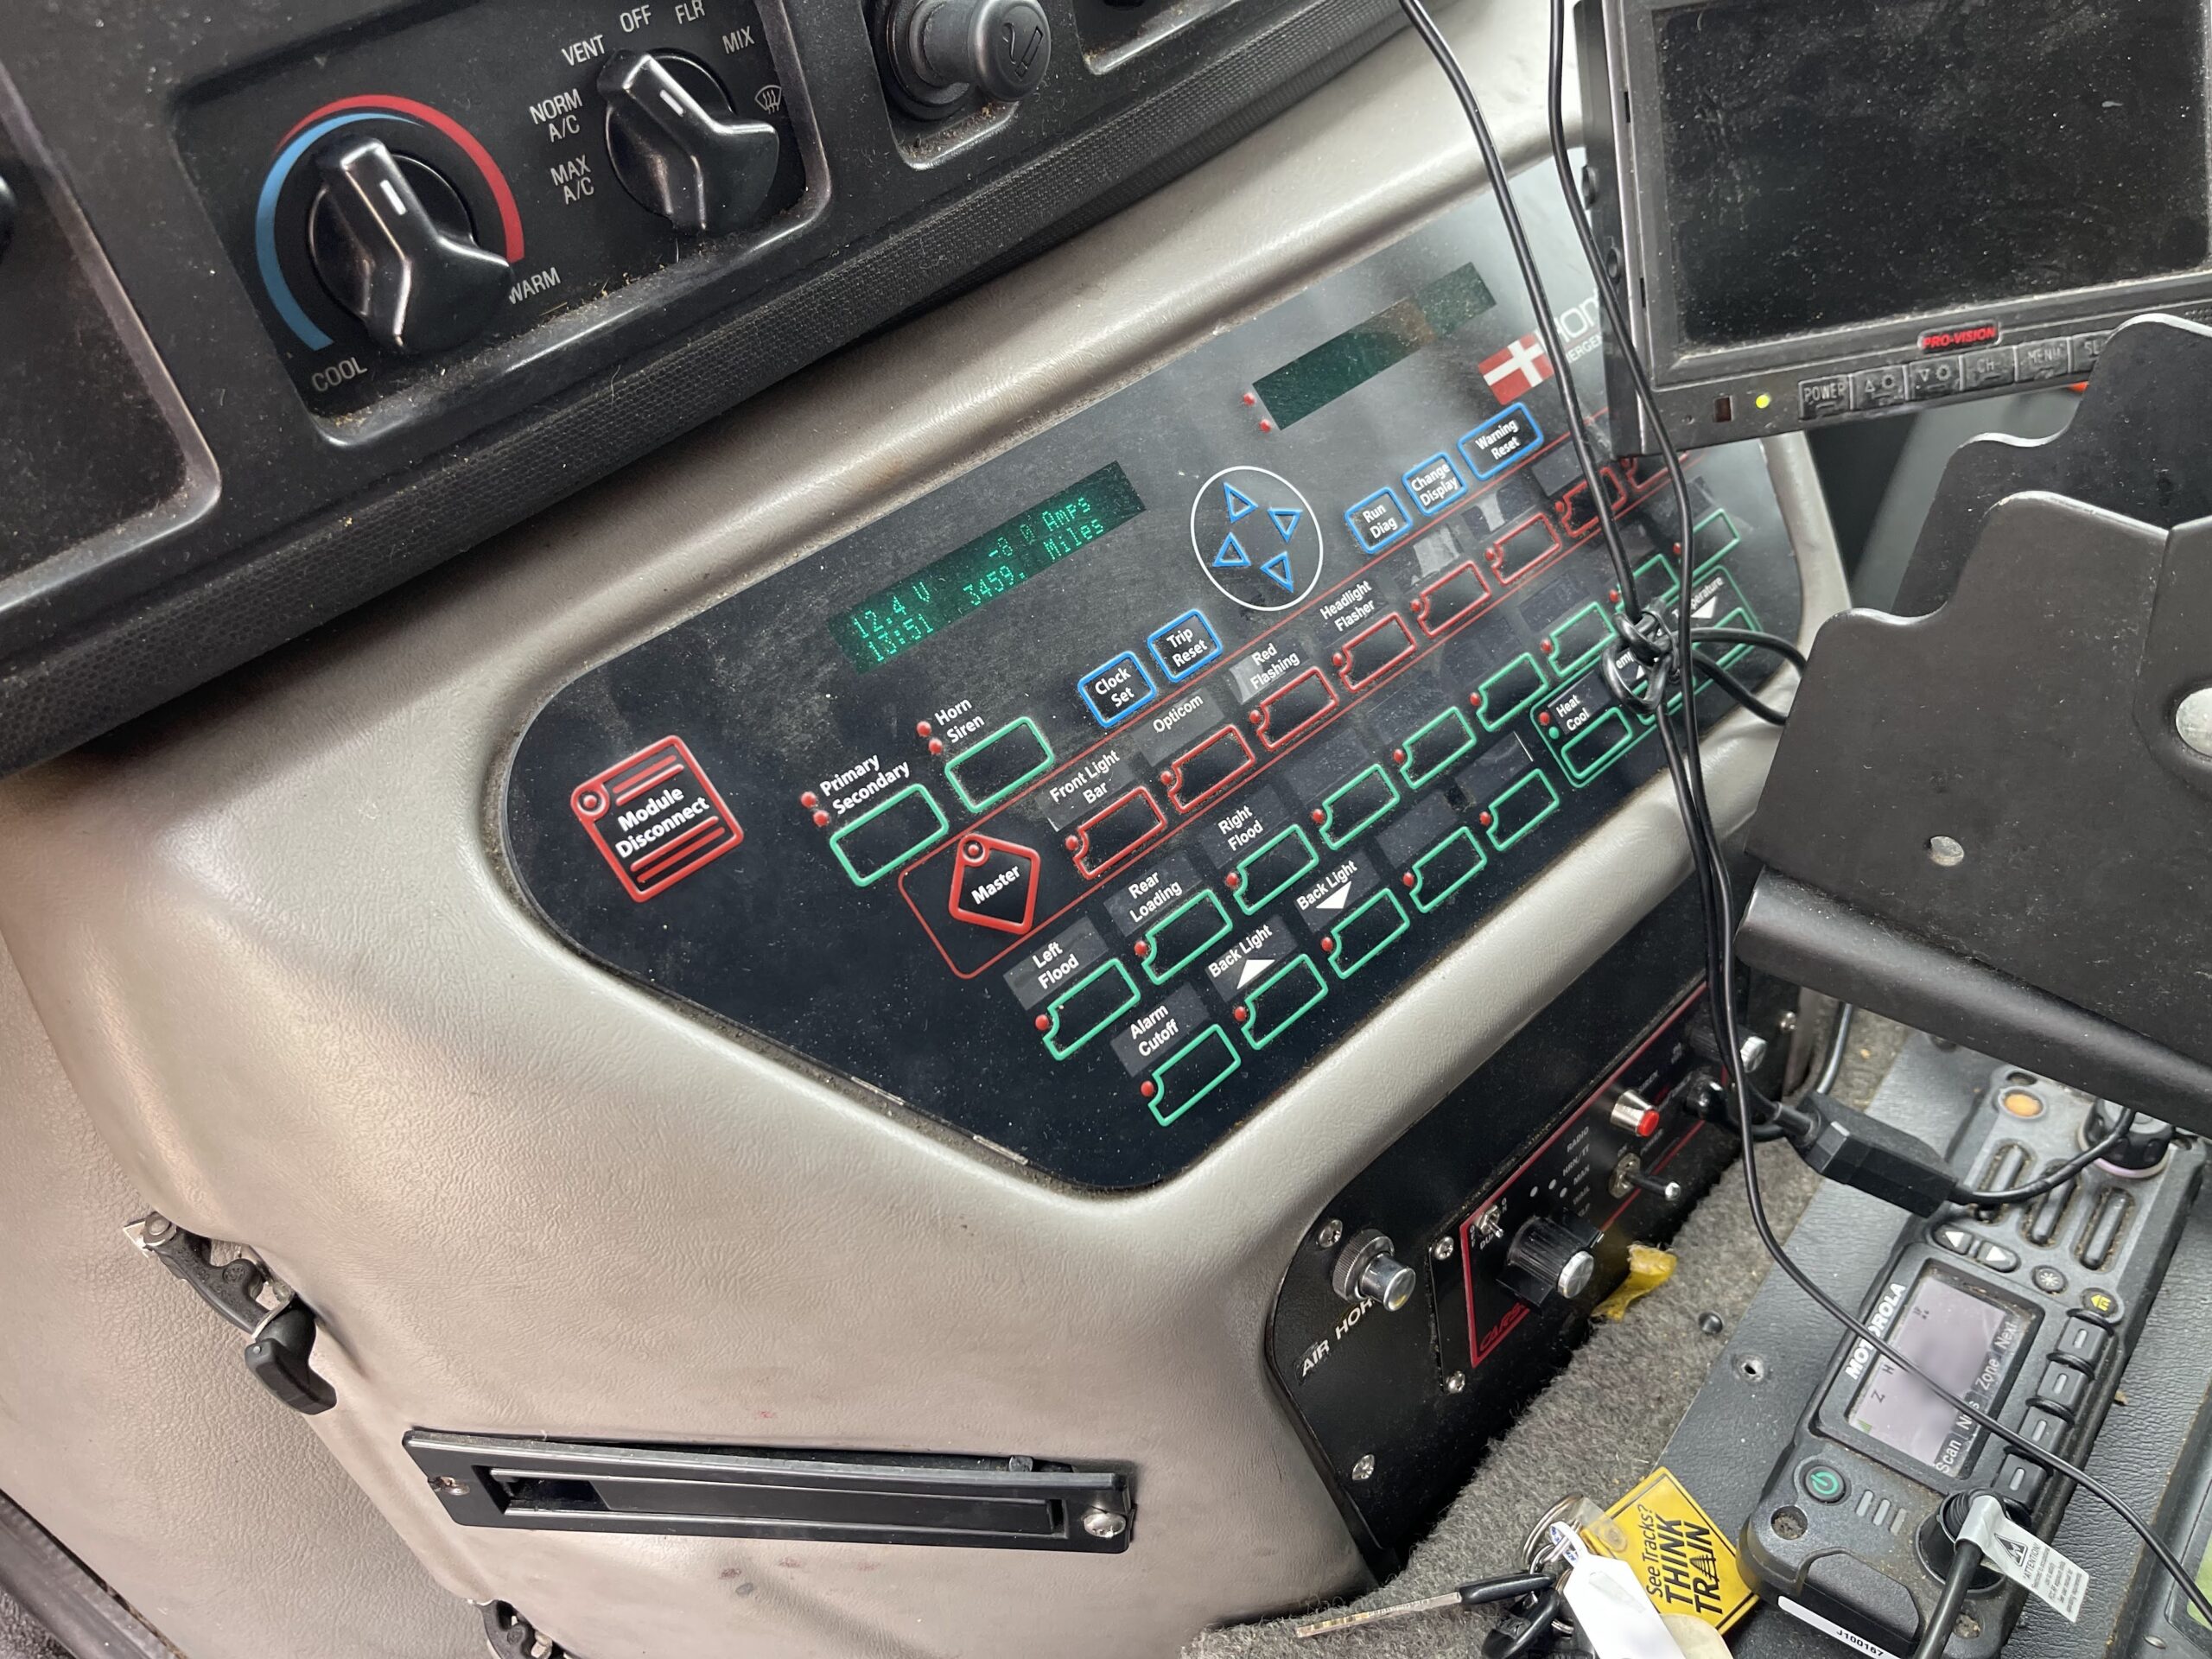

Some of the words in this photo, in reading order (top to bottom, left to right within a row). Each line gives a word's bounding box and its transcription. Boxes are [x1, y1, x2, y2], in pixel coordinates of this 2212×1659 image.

[620, 4, 652, 33] OFF
[675, 1, 706, 25] FLR
[562, 35, 606, 67] VENT
[722, 27, 754, 53] MIX
[531, 89, 582, 124] NORM
[549, 115, 580, 142] A/C
[550, 157, 592, 185] MAX
[563, 177, 594, 204] A/C
[510, 267, 561, 303] WARM
[1923, 327, 1996, 348] PRO-VISION
[311, 356, 367, 392] COOL
[1804, 383, 1847, 403] POWER
[1475, 420, 1518, 450] Warning
[1491, 436, 1520, 461] Reset
[1410, 464, 1451, 492] Change
[1421, 475, 1459, 506] Display
[1363, 502, 1386, 525] Run
[1369, 515, 1398, 540] Diag
[853, 596, 906, 638] 12.4
[913, 582, 930, 602] V
[1042, 498, 1090, 531] Amps
[868, 613, 933, 661] 13:51
[1044, 519, 1103, 560] Miles
[1319, 580, 1372, 619] Headlight
[1335, 599, 1376, 632] Flasher
[1167, 627, 1194, 652] Trip
[1173, 639, 1207, 667] Reset
[1253, 643, 1278, 666] Red
[1095, 667, 1131, 696] Clock
[1251, 650, 1300, 690] Flashing
[935, 697, 972, 727] Horn
[1110, 686, 1135, 708] Set
[1556, 694, 1580, 718] Heat
[947, 714, 985, 742] Siren
[1154, 694, 1204, 734] Opticom
[1566, 708, 1590, 731] Cool
[820, 754, 880, 797] Primary
[832, 760, 911, 816] Secondary
[1049, 772, 1084, 804] Front
[1084, 749, 1120, 781] Light
[1084, 780, 1109, 804] Bar
[617, 785, 684, 833] Module
[1218, 806, 1254, 836] Right
[616, 797, 709, 859] Disconnect
[1227, 821, 1263, 853] Flood
[971, 866, 1020, 905] Master
[1128, 872, 1160, 899] Rear
[1129, 880, 1183, 922] Loading
[1296, 883, 1326, 911] Back
[1326, 861, 1358, 889] Light
[1033, 941, 1062, 969] Left
[1208, 949, 1242, 979] Back
[1242, 924, 1273, 957] Light
[1038, 953, 1078, 988] Flood
[1129, 1006, 1169, 1039] Alarm
[1138, 1025, 1179, 1058] Cutoff
[1567, 1126, 1589, 1153] RADIO
[1302, 1339, 1330, 1377] AIR
[1936, 1439, 1961, 1473] Scan
[1976, 1358, 1999, 1390] Zone
[1995, 1321, 2018, 1349] Next
[1637, 1504, 1658, 1561] Tracks?
[1656, 1514, 1694, 1604] THINK
[1684, 1522, 1723, 1614] TRAIN
[1646, 1569, 1663, 1598] See
